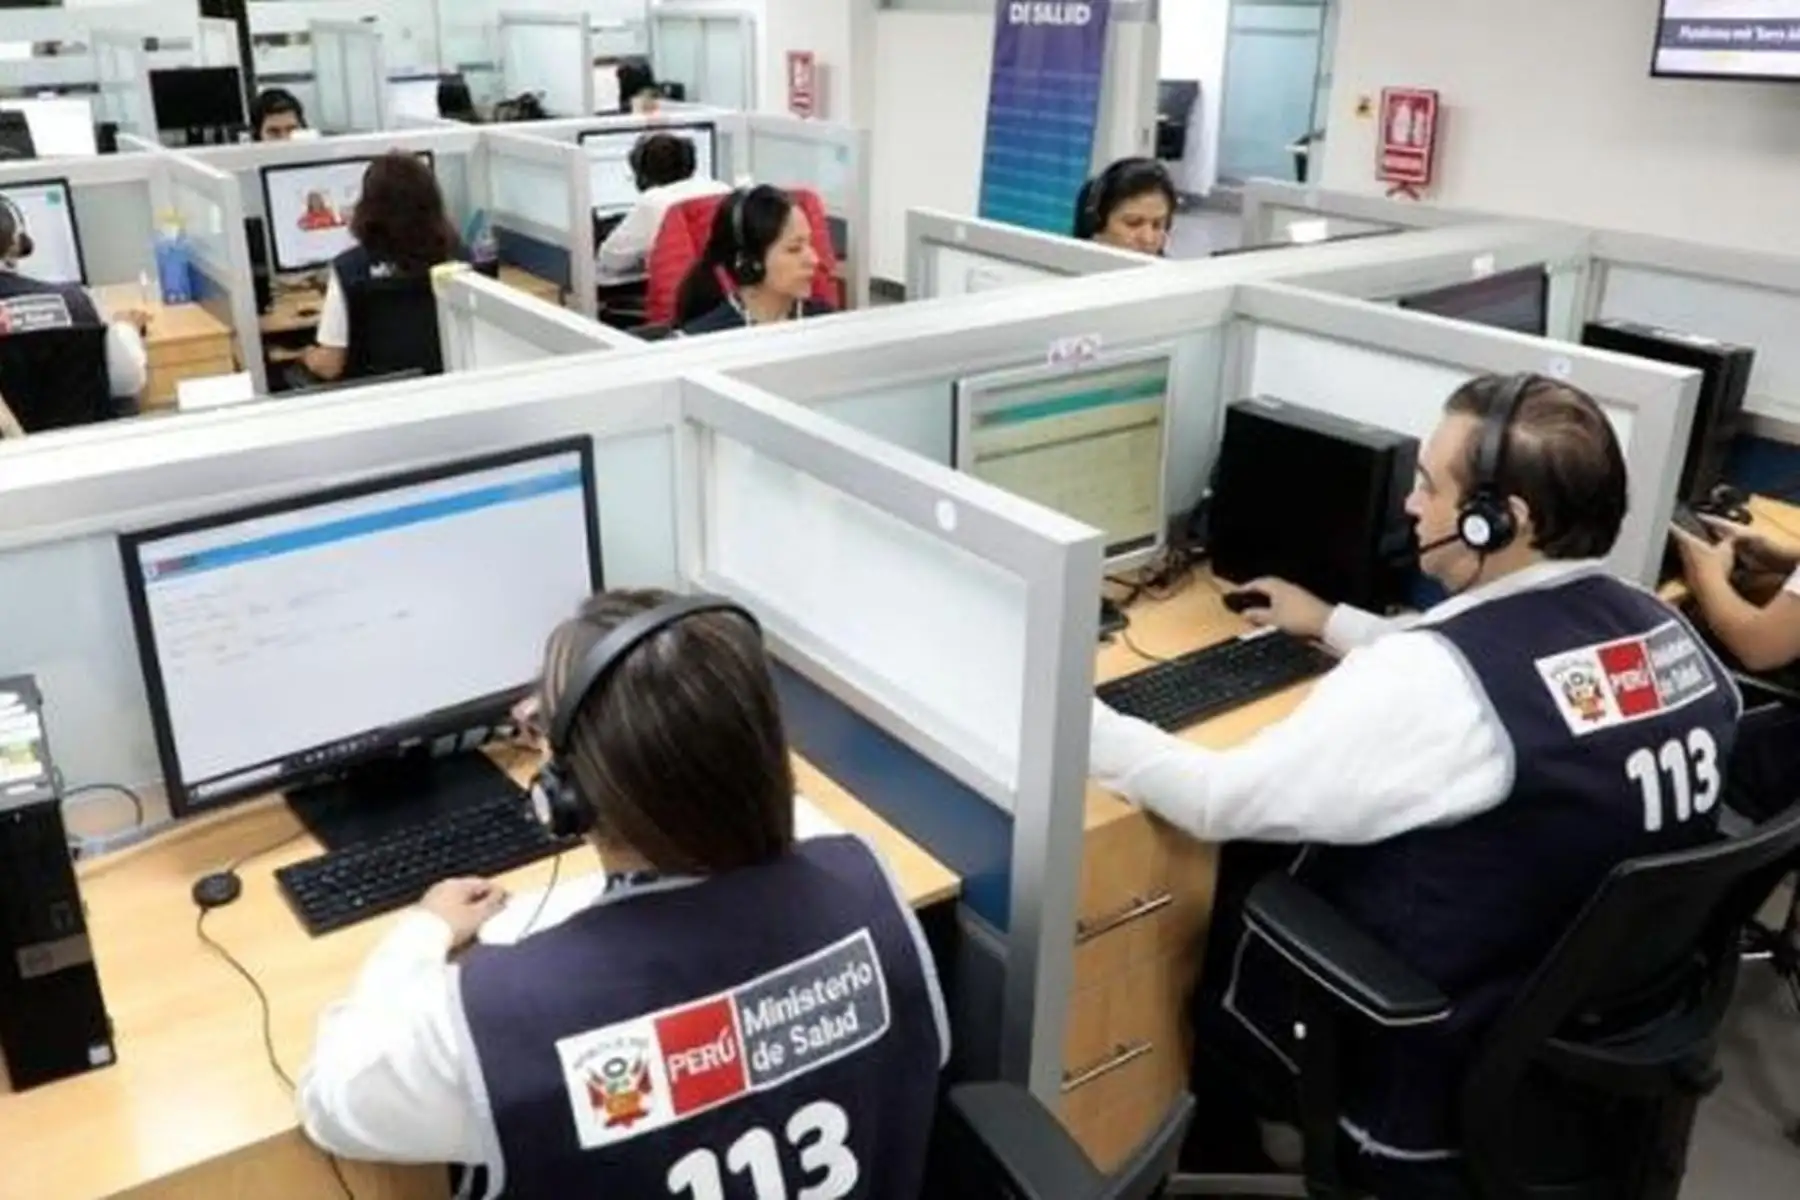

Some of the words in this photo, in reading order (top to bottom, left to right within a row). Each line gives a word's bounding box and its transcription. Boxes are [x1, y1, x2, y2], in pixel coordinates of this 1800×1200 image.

[1625, 727, 1721, 832] 113
[743, 961, 873, 1037] Ministerio
[751, 1041, 785, 1072] de
[789, 1001, 859, 1055] Salud
[667, 1025, 736, 1084] PERÚ
[667, 1099, 859, 1200] 113
